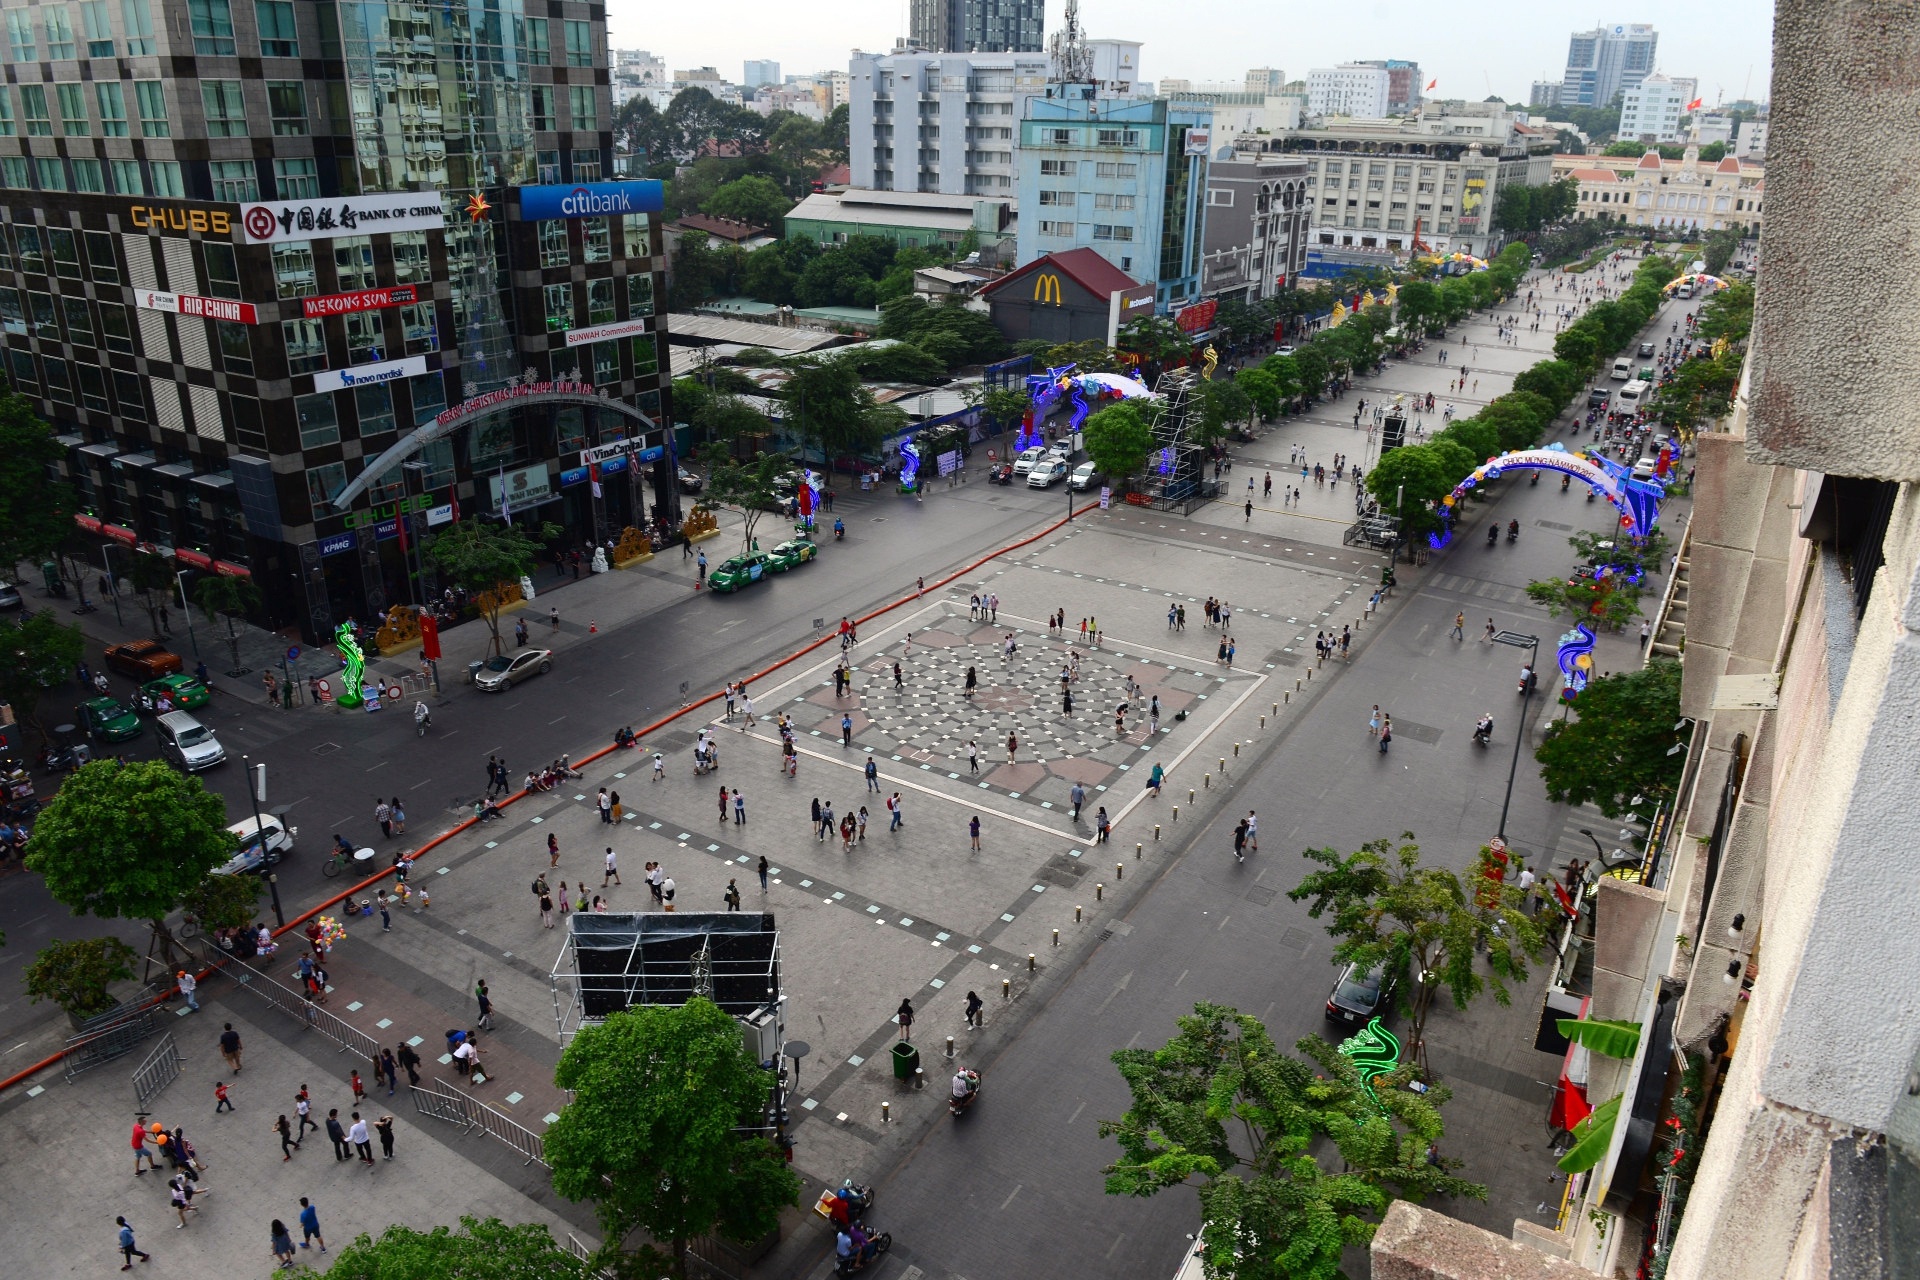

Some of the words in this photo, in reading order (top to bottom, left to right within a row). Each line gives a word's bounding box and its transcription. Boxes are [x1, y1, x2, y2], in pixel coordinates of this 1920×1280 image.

[562, 188, 631, 215] citibank
[131, 206, 232, 234] CHUBB
[359, 208, 390, 221] BANK
[392, 208, 406, 216] OF
[410, 204, 443, 216] CHINA
[306, 296, 360, 314] MEKONG
[364, 292, 387, 307] SUN
[389, 294, 416, 302] COFFEE
[184, 297, 203, 315] AIR
[205, 299, 240, 320] CHINA
[568, 331, 600, 344] SUNWAH
[602, 324, 642, 337] Commodities
[356, 374, 376, 385] novo
[376, 368, 403, 381] nordisk
[436, 404, 464, 426] MERRY
[464, 388, 510, 414] CHRISTMAS
[511, 384, 528, 398] AND
[531, 382, 554, 394] HAPPY
[557, 382, 573, 394] NEW
[576, 382, 593, 396] YEAR
[594, 438, 643, 460] VinaCaptal
[568, 474, 580, 483] citi
[526, 484, 548, 497] TOWER
[435, 507, 446, 516] ANA
[324, 540, 350, 554] KPMG
